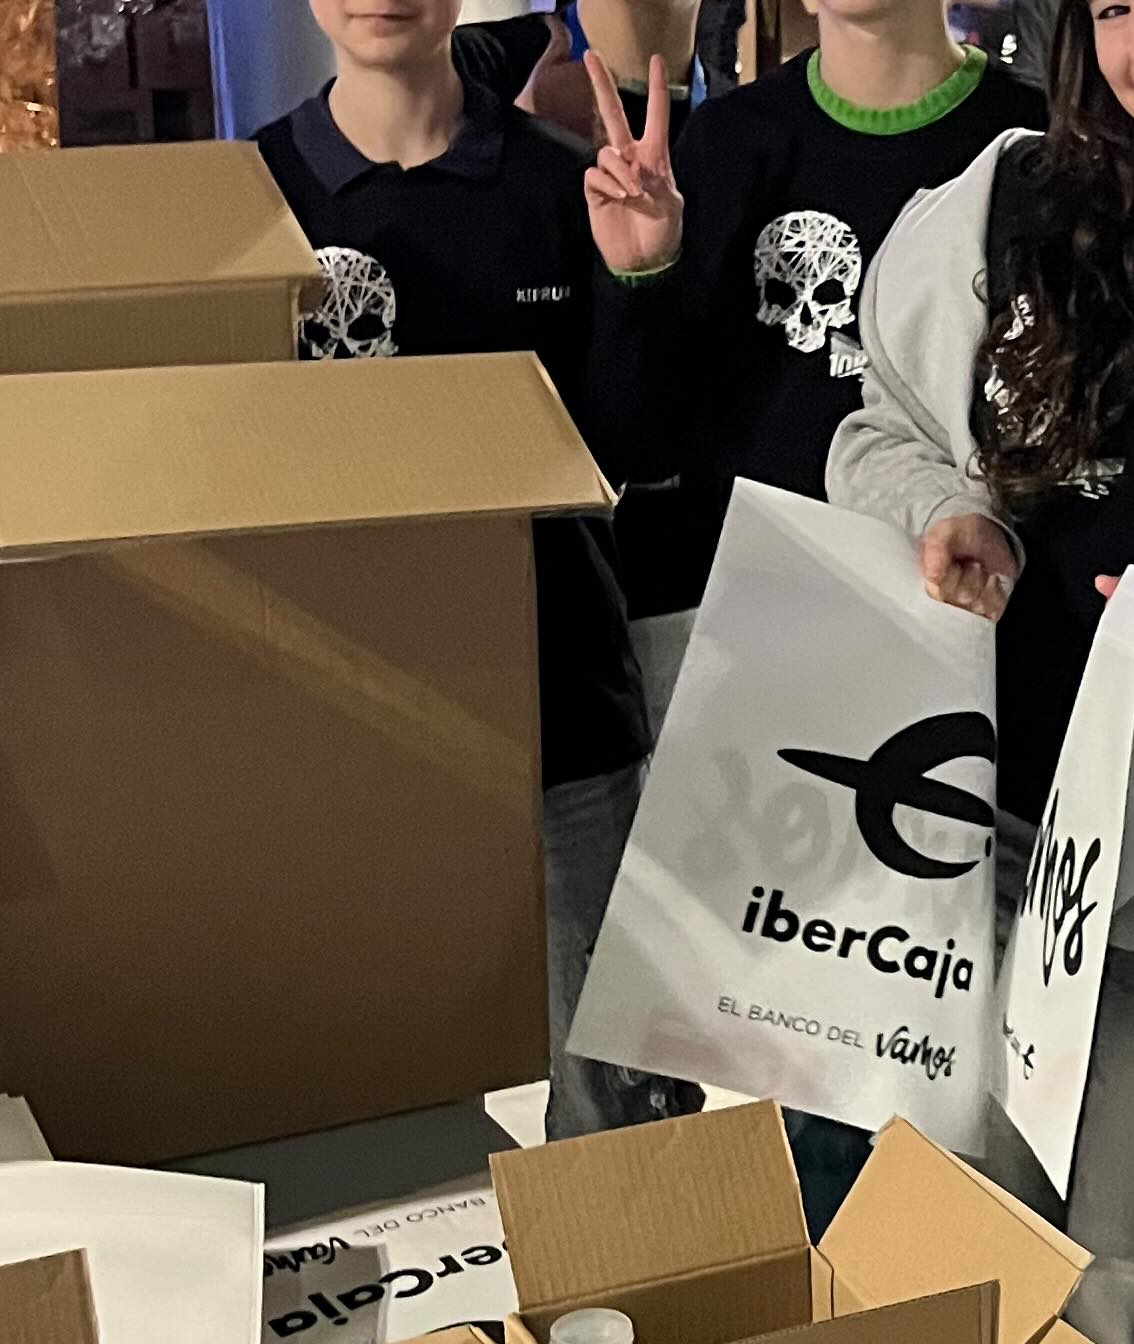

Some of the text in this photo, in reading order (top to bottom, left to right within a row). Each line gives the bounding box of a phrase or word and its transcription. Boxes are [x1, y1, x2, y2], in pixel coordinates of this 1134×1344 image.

[742, 886, 974, 999] iberCaja
[718, 996, 741, 1017] EL
[748, 1005, 821, 1036] BANCO
[826, 1025, 864, 1049] DEL
[268, 1242, 505, 1338] erCaja
